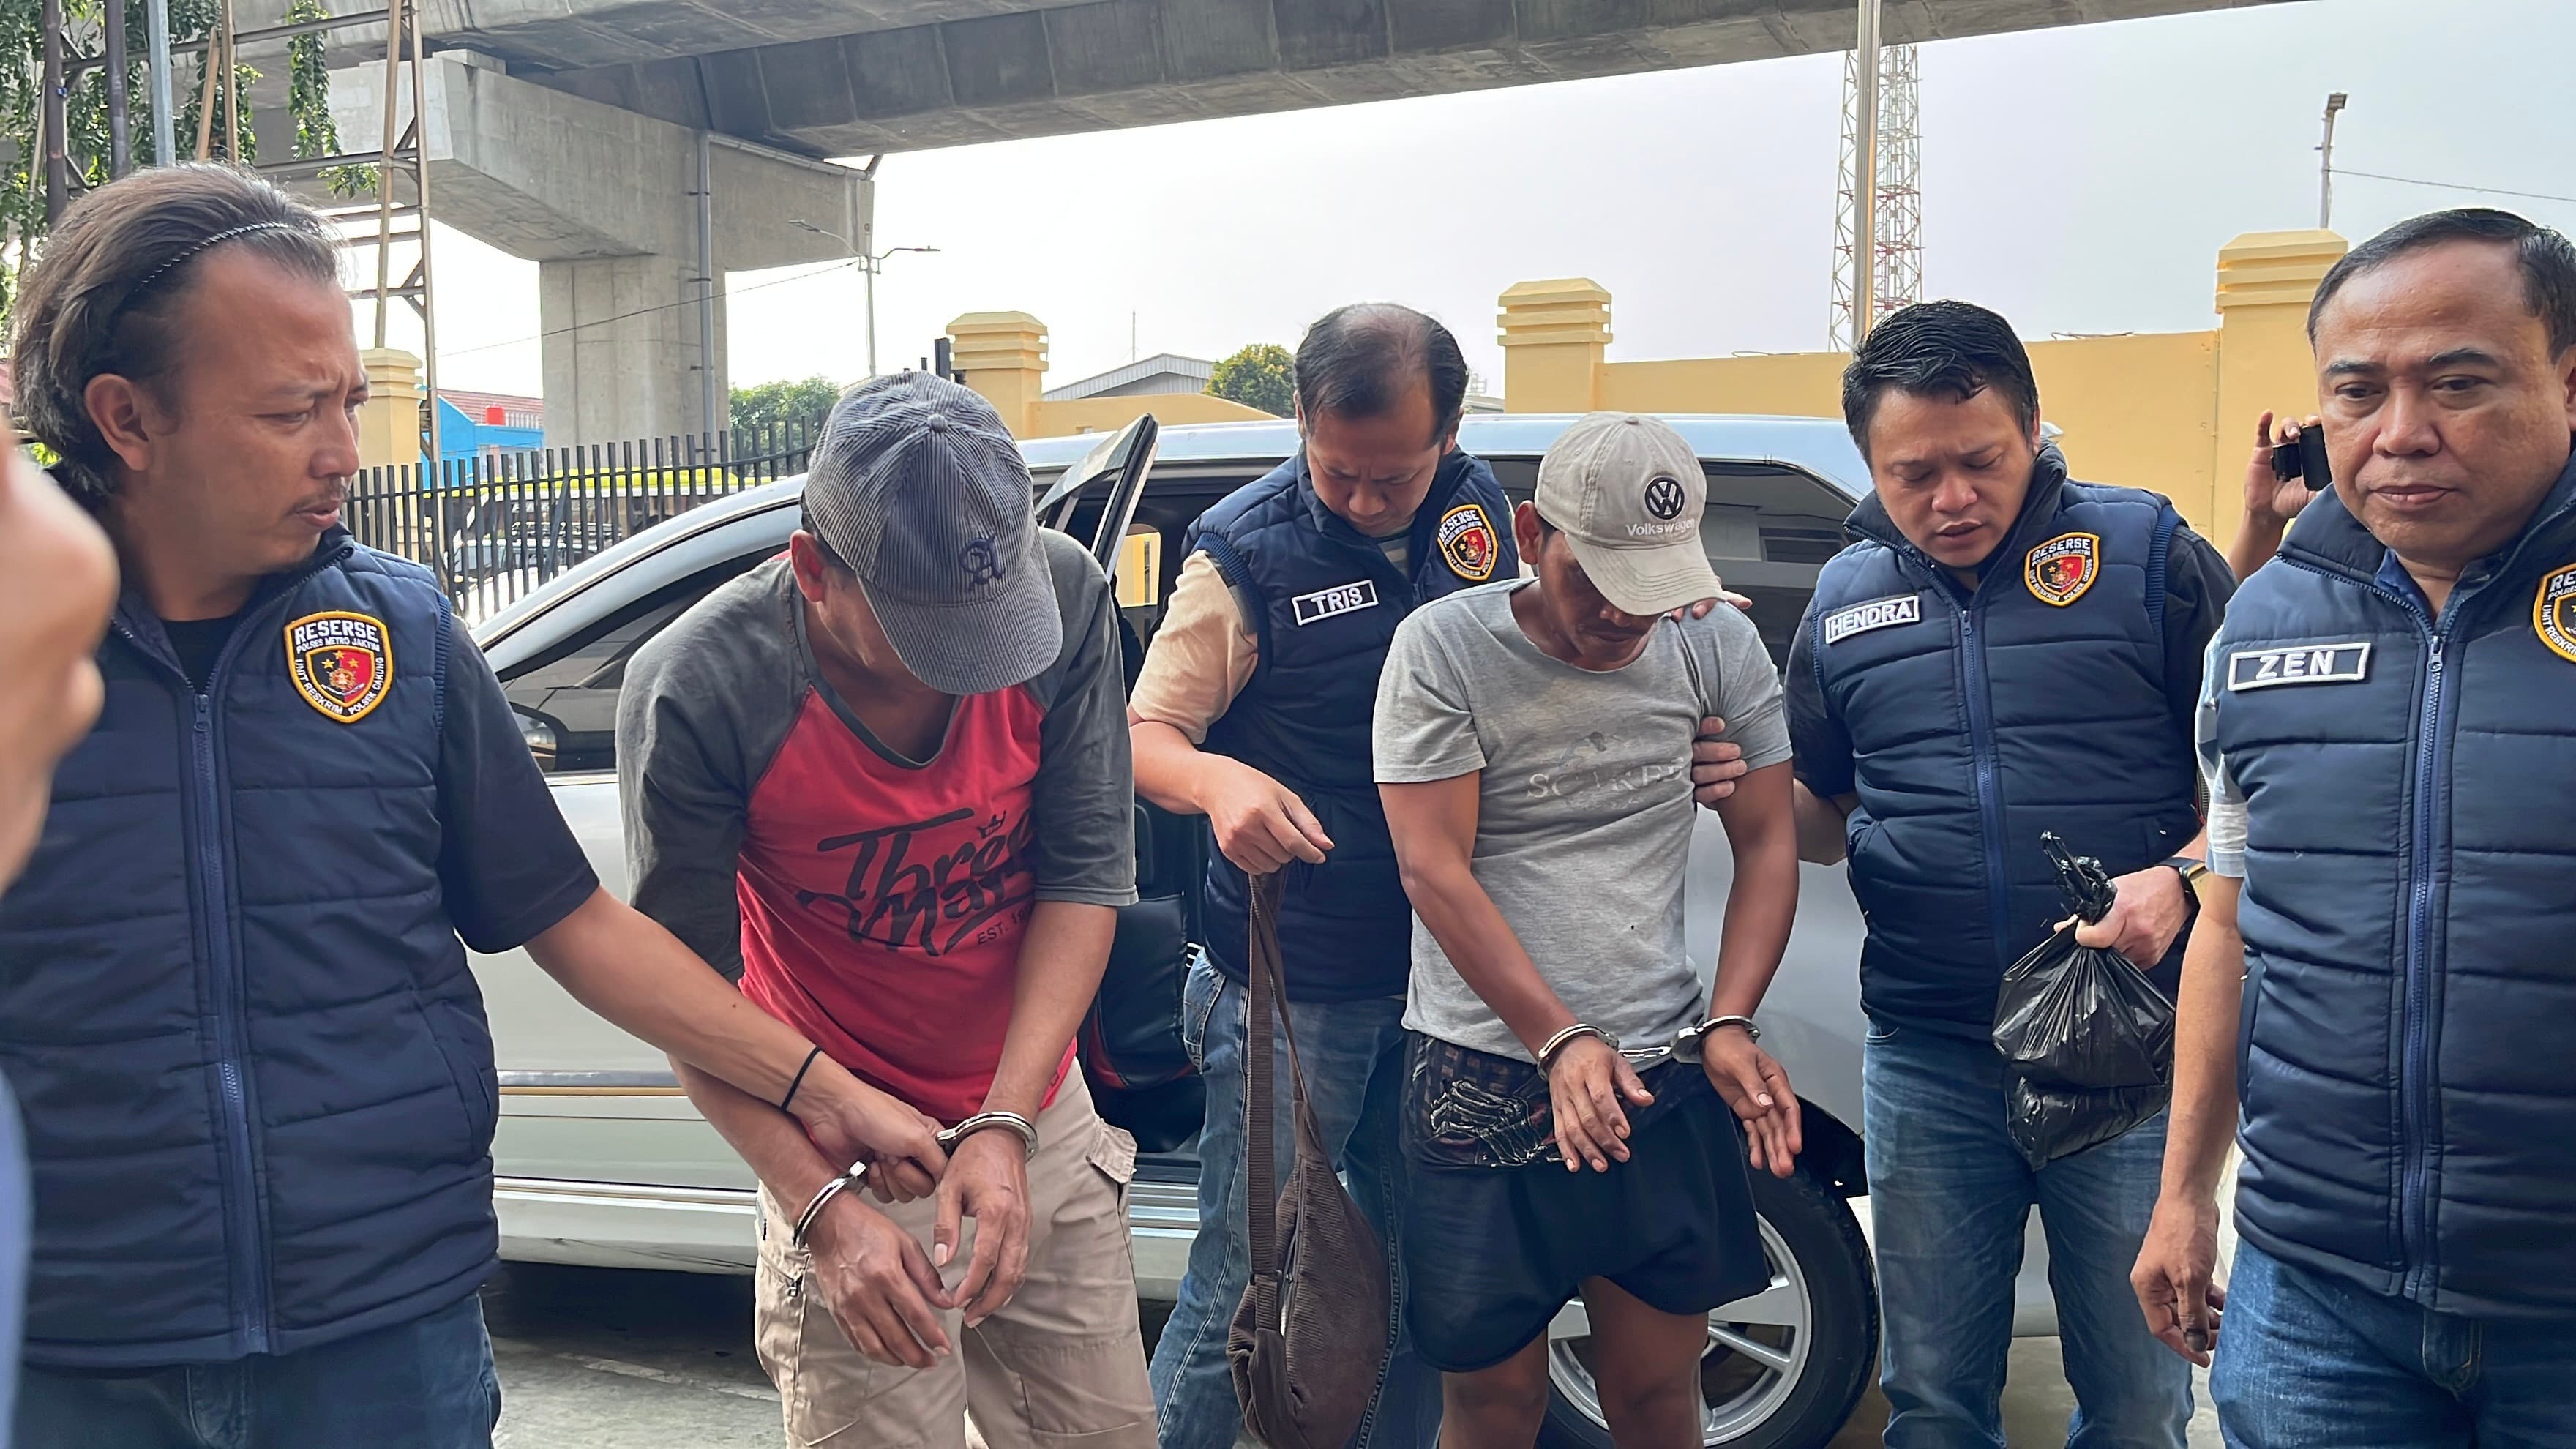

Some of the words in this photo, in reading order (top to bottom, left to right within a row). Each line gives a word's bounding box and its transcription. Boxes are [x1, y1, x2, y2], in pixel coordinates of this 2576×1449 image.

[1625, 519, 1695, 536] Volkswagen
[2032, 538, 2091, 561] RESERSE
[2550, 571, 2576, 592] RE
[1310, 588, 1363, 615] TRIS
[295, 620, 379, 645] RESERSE
[1831, 602, 1912, 637] HENDRA
[296, 637, 324, 654] POLRES
[325, 637, 350, 645] METRO
[351, 637, 381, 652] JAKTIM
[2545, 626, 2576, 656] RESKRI
[2255, 650, 2335, 681] ZEN
[295, 659, 309, 683] UNIT
[304, 683, 343, 714] RESKRIM
[348, 691, 376, 714] POLSEK
